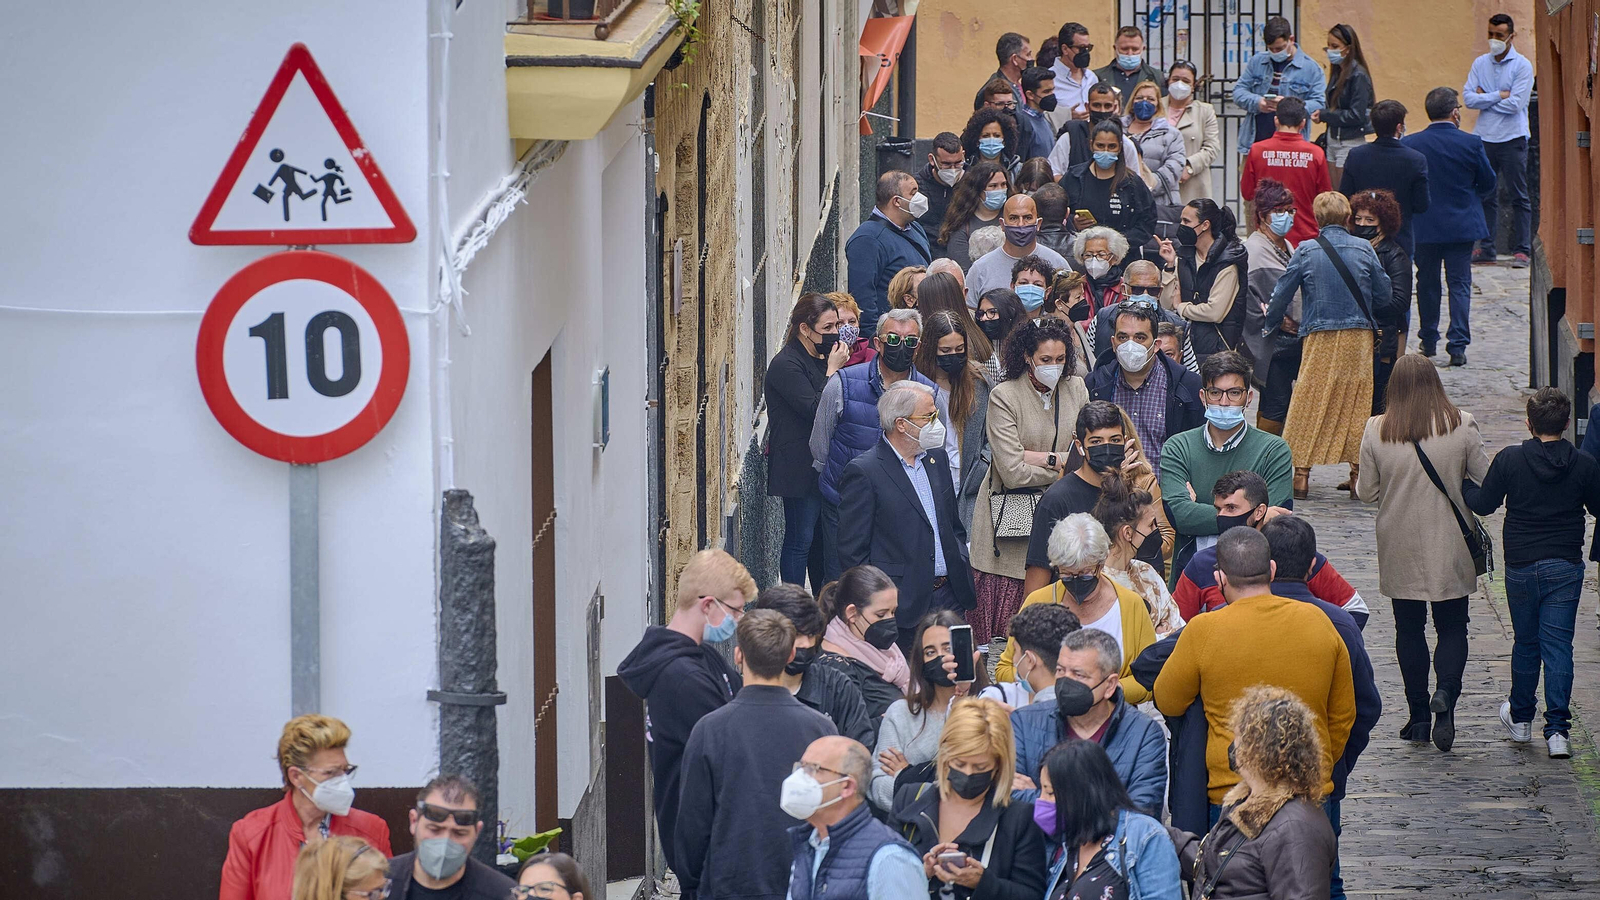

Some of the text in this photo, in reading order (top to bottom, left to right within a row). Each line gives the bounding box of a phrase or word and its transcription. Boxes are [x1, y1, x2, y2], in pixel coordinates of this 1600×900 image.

[1262, 150, 1313, 161] CLUB TENIS DE MESA
[248, 310, 361, 400] 10
